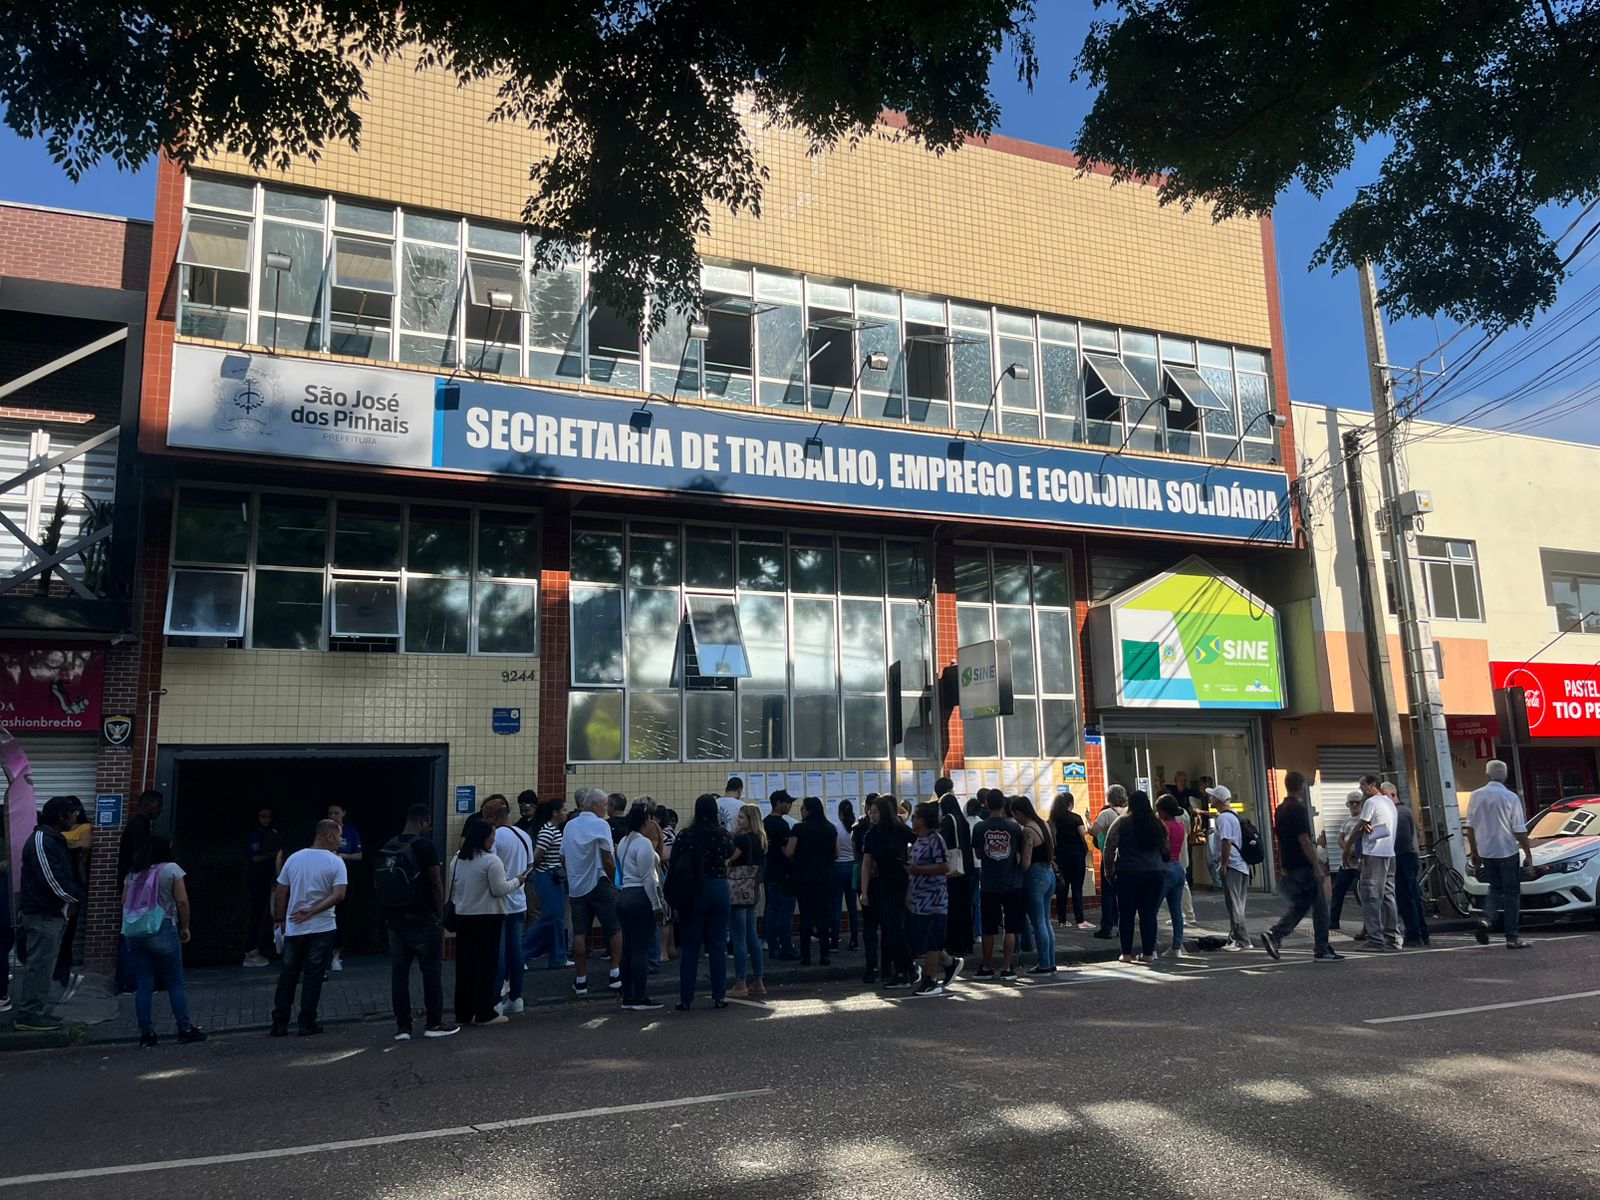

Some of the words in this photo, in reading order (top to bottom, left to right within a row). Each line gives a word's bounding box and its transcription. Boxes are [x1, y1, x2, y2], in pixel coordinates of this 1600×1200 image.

[303, 384, 348, 407] São
[351, 389, 400, 413] José
[291, 405, 329, 426] dos
[333, 410, 409, 434] Pinhais
[322, 432, 377, 445] PREFEITURA
[466, 406, 674, 467] SECRETARIA
[681, 431, 720, 472] DE
[726, 436, 884, 491] TRABALHO,
[889, 452, 1013, 499] EMPREGO
[1018, 465, 1033, 500] E
[1036, 467, 1163, 511] ECONOMIA
[501, 670, 535, 683] 9244
[1552, 701, 1582, 719] TIO
[0, 715, 82, 727] ashionbrecho
